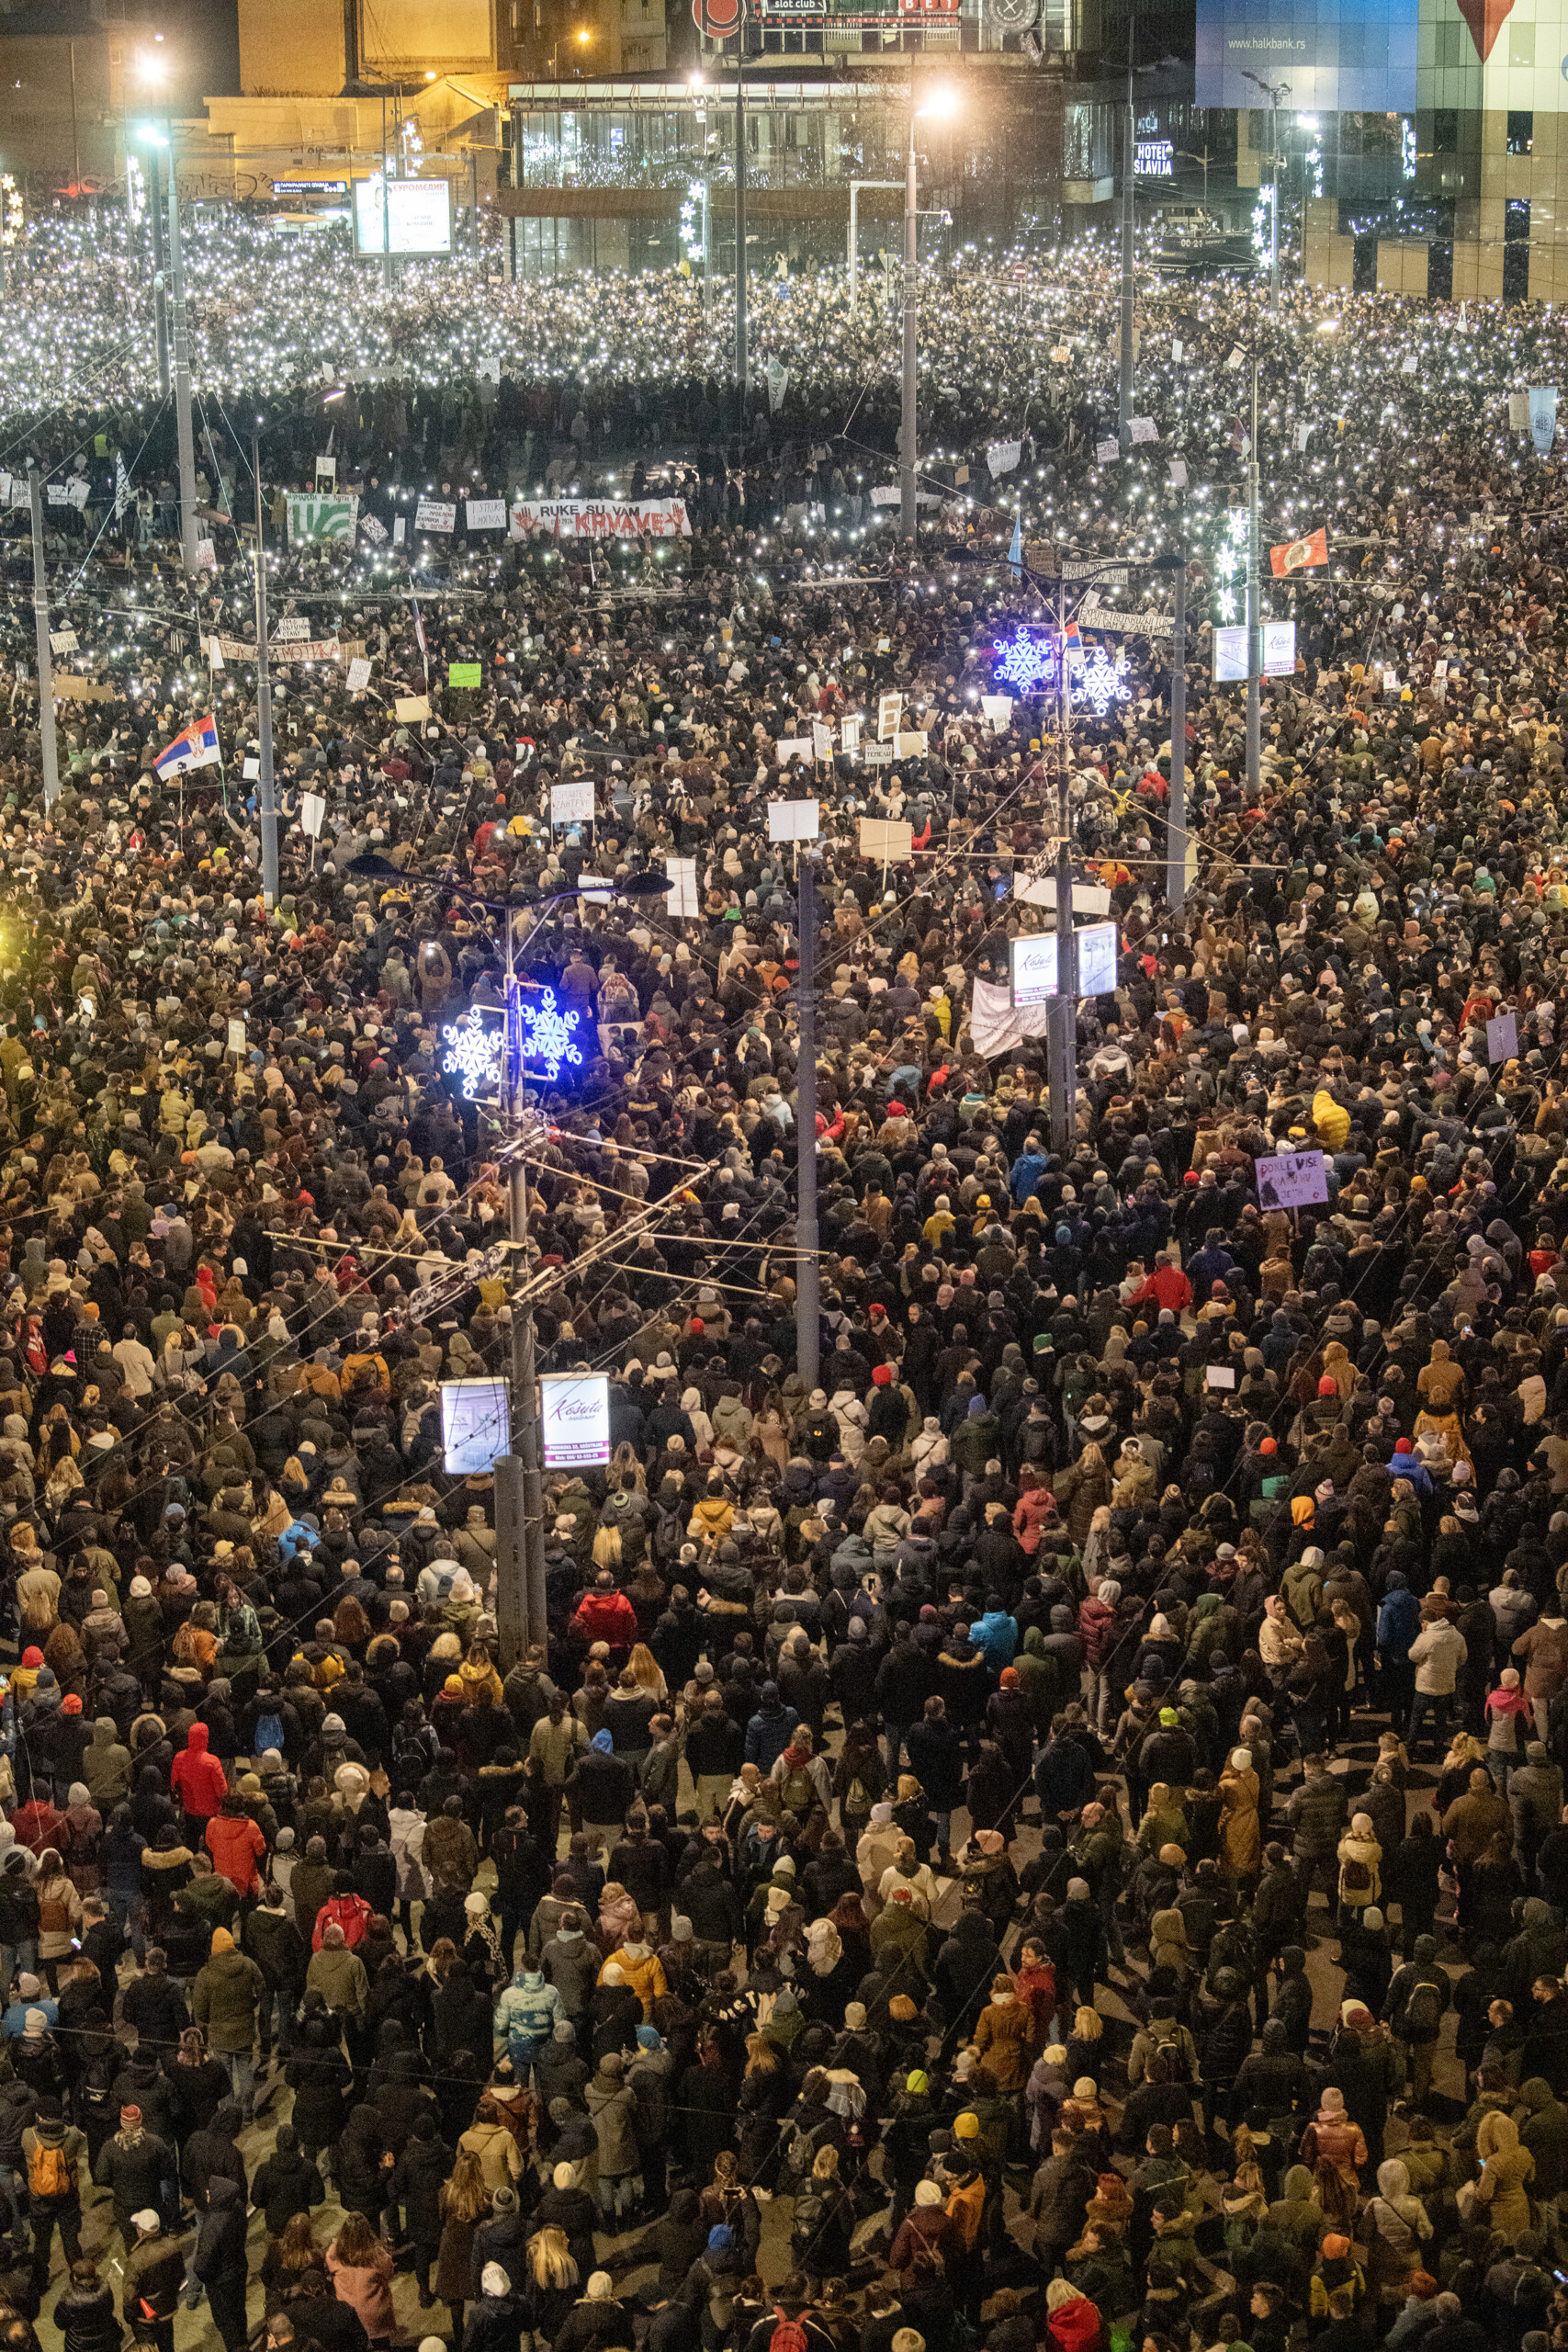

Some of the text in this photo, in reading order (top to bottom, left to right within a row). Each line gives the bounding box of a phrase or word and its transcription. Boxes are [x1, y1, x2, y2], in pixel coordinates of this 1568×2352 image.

[774, 0, 816, 8] slot club
[1228, 38, 1306, 50] www.halkbank.rs
[1137, 144, 1168, 160] HOTEL
[1134, 160, 1173, 175] SLAVIJA
[479, 502, 505, 513] STRUKA
[540, 504, 640, 517] RUKE SU VAM
[575, 513, 665, 536] KRVAVE
[1080, 607, 1100, 619] EXPO
[1100, 611, 1125, 623] METRO
[282, 642, 338, 661] МОТИКА
[548, 1397, 604, 1421] Košuta
